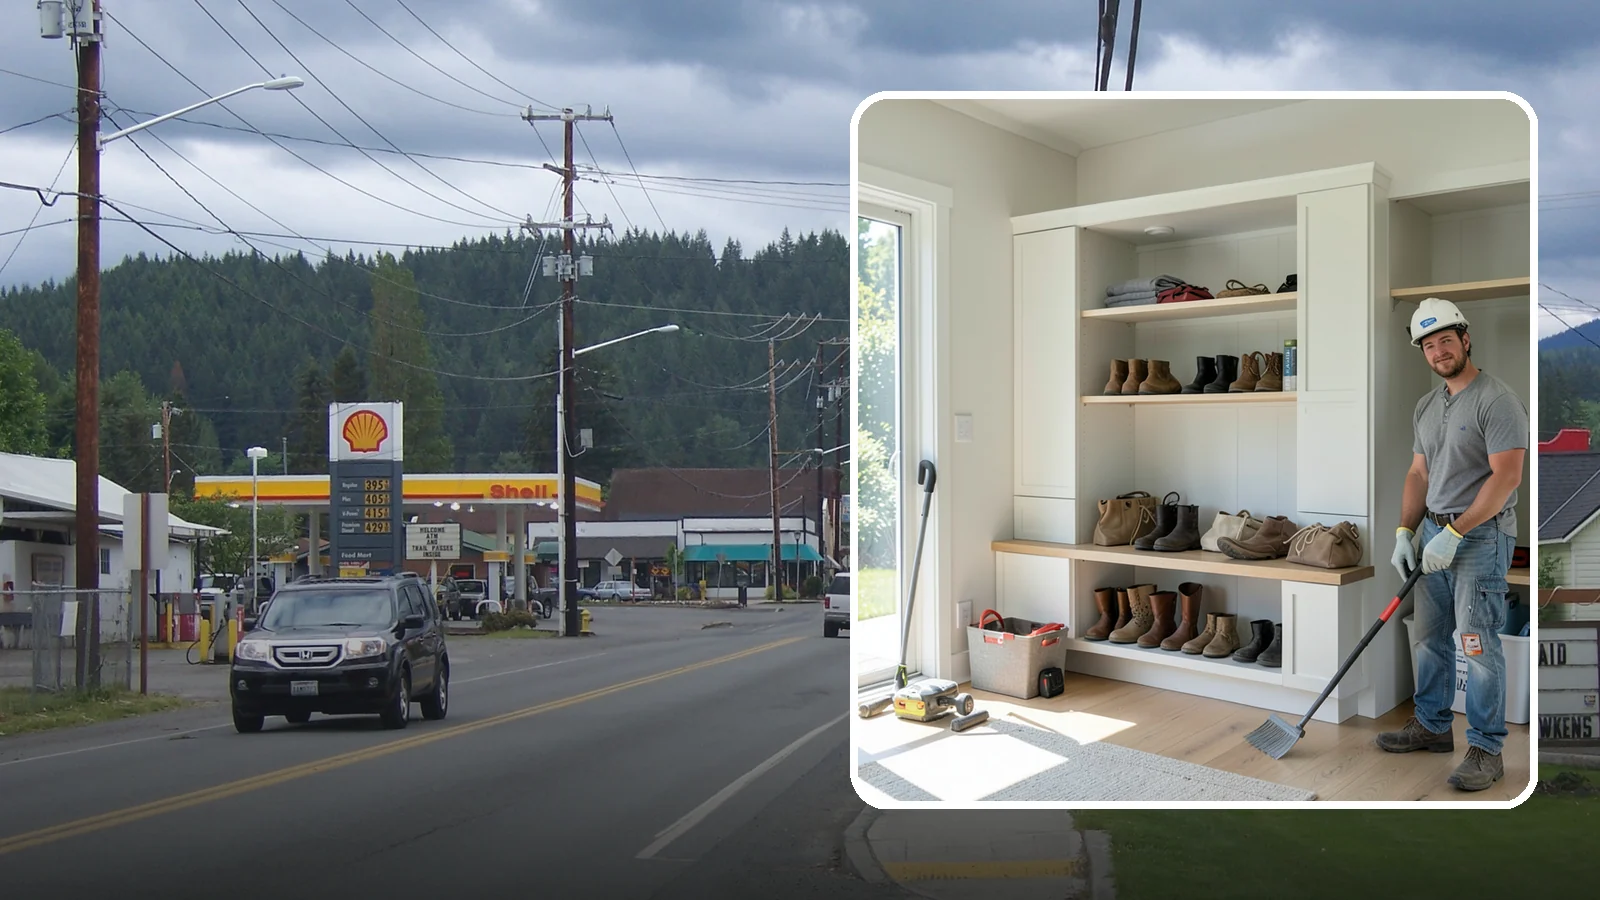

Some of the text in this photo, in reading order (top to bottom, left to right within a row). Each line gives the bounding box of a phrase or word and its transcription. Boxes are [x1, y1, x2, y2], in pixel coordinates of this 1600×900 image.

[366, 480, 383, 490] 395
[490, 484, 547, 499] Shell
[365, 494, 383, 504] 405
[365, 508, 383, 518] 415
[365, 522, 383, 533] 429
